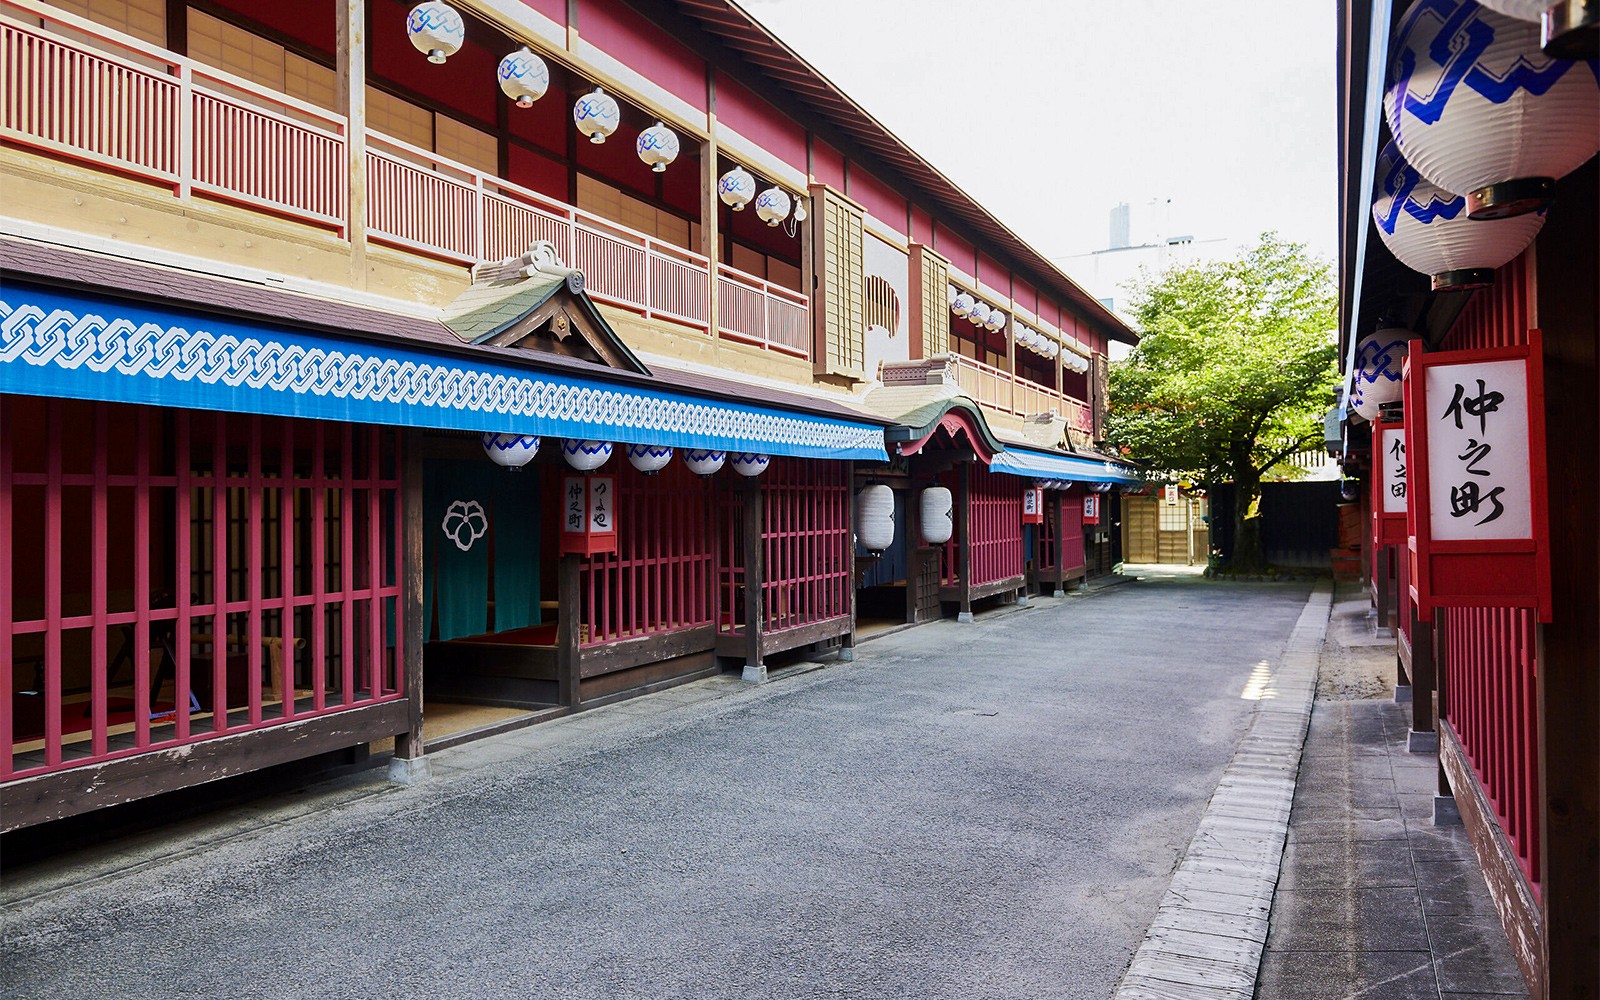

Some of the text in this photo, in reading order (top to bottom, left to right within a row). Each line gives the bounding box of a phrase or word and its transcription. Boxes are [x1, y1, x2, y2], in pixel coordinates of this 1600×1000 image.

[1441, 379, 1506, 527] 仲之町
[568, 483, 582, 528] 仲之町
